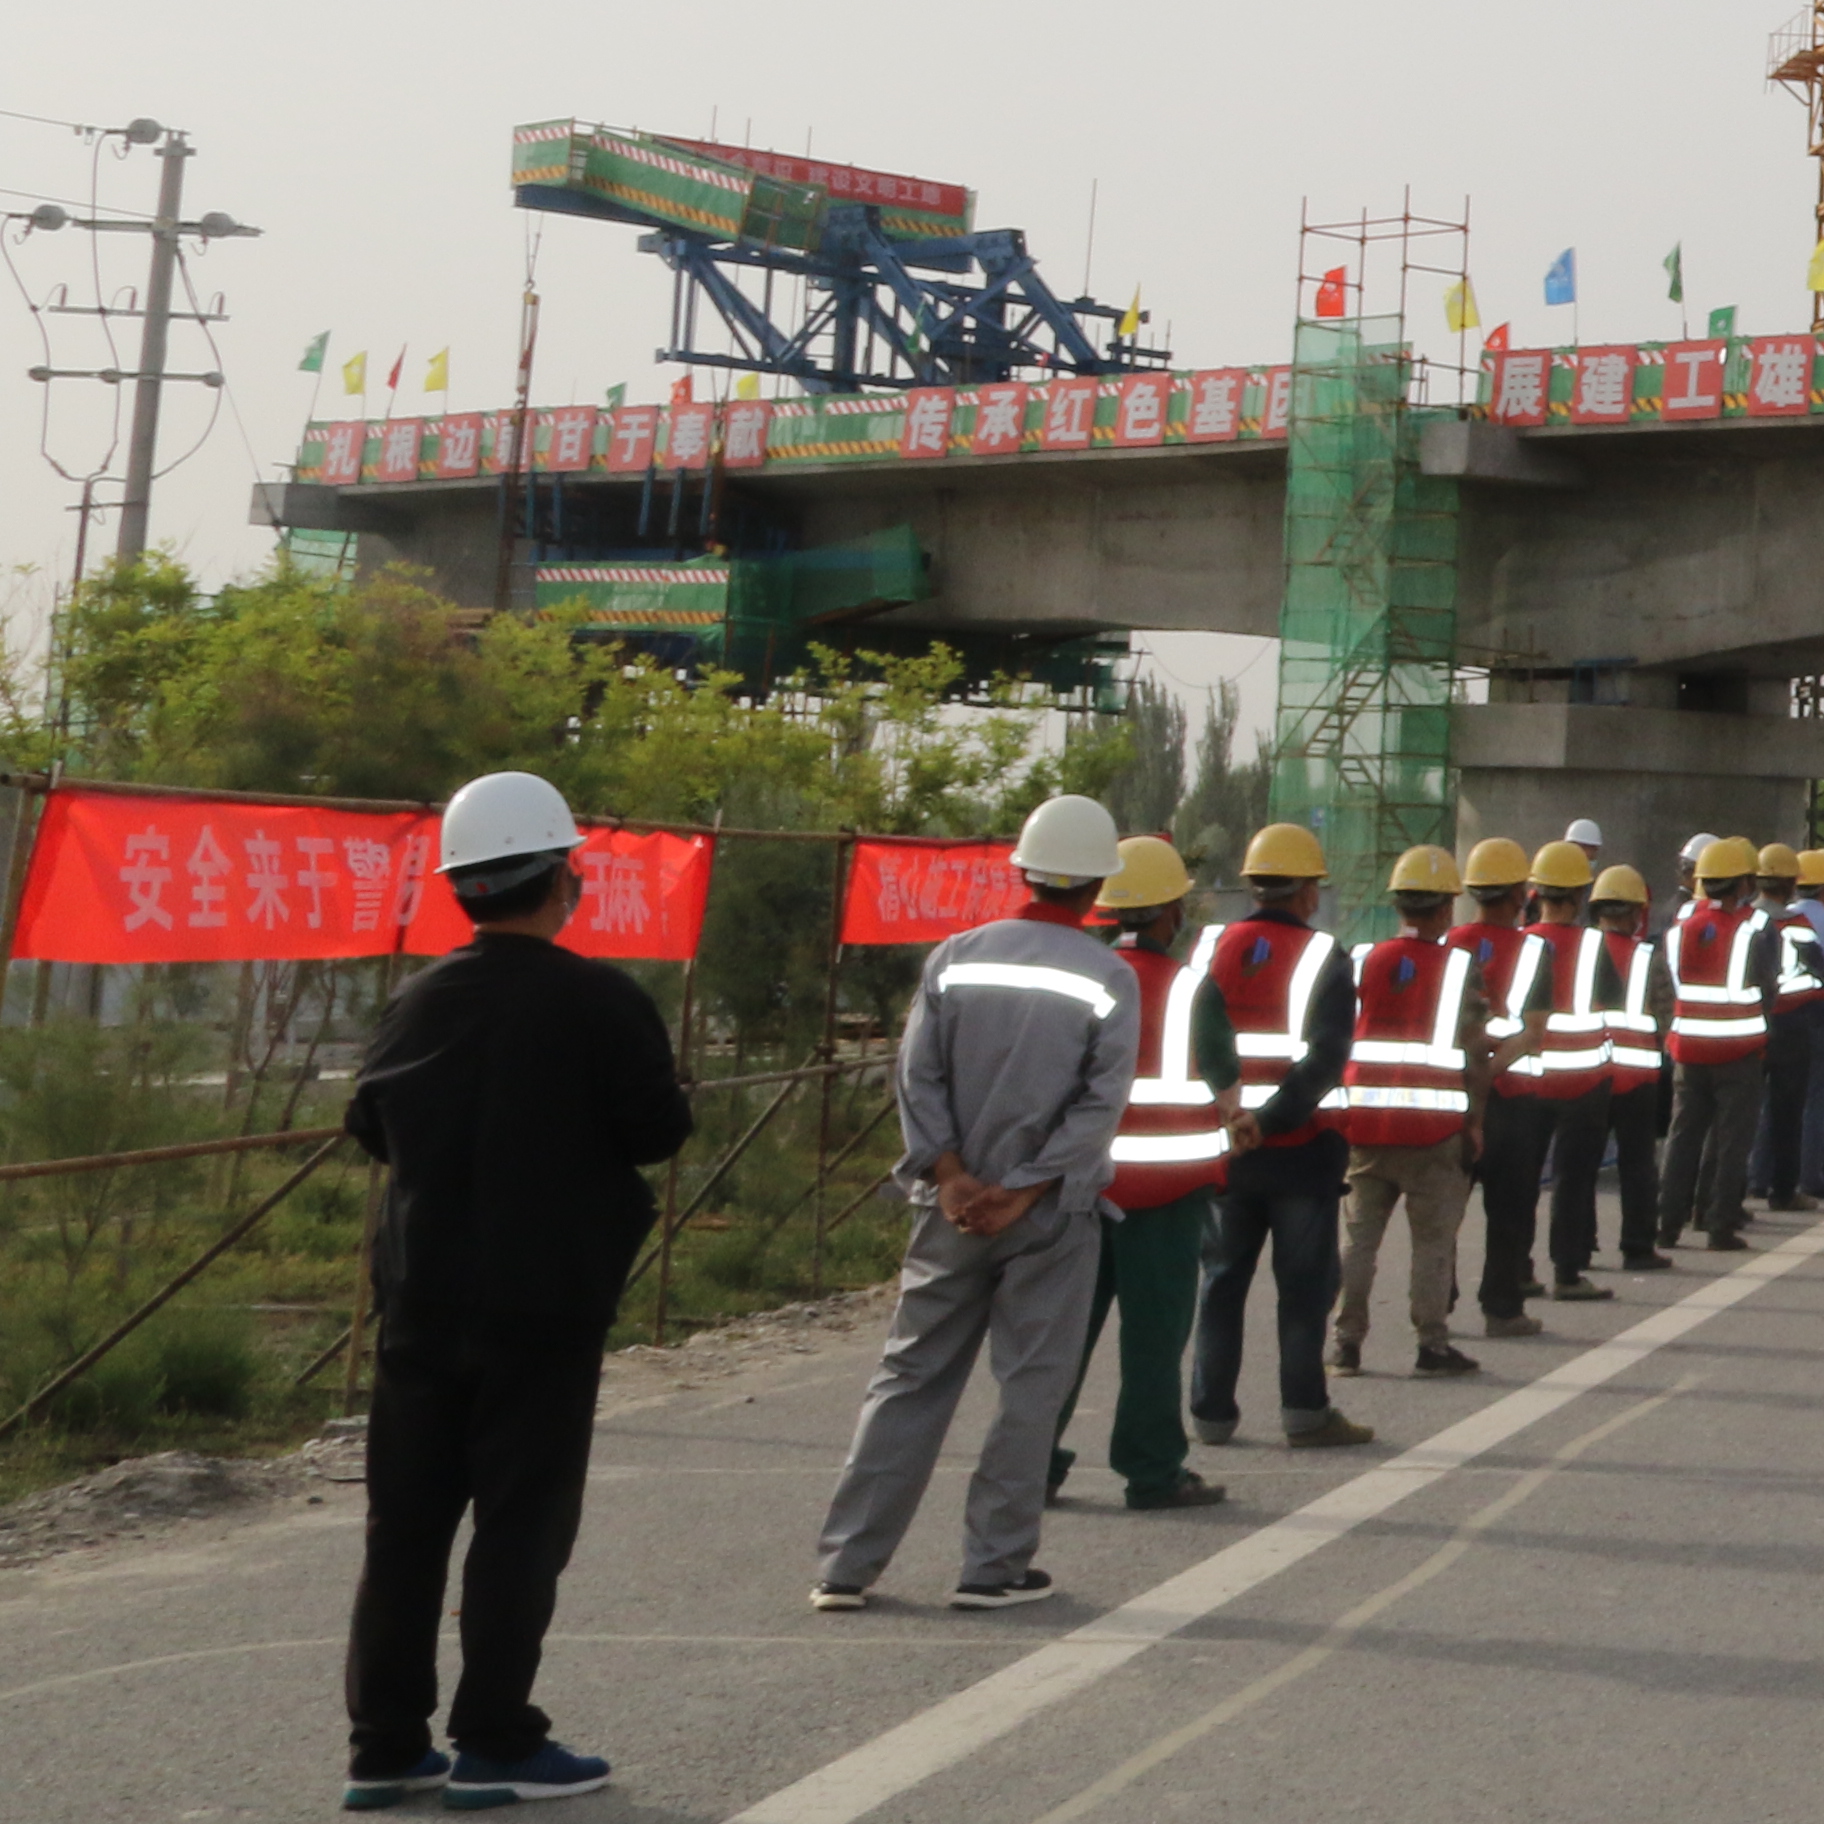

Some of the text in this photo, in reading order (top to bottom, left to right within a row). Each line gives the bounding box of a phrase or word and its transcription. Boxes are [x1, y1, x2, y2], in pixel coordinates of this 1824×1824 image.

[908, 376, 1307, 452] 传承红色基因
